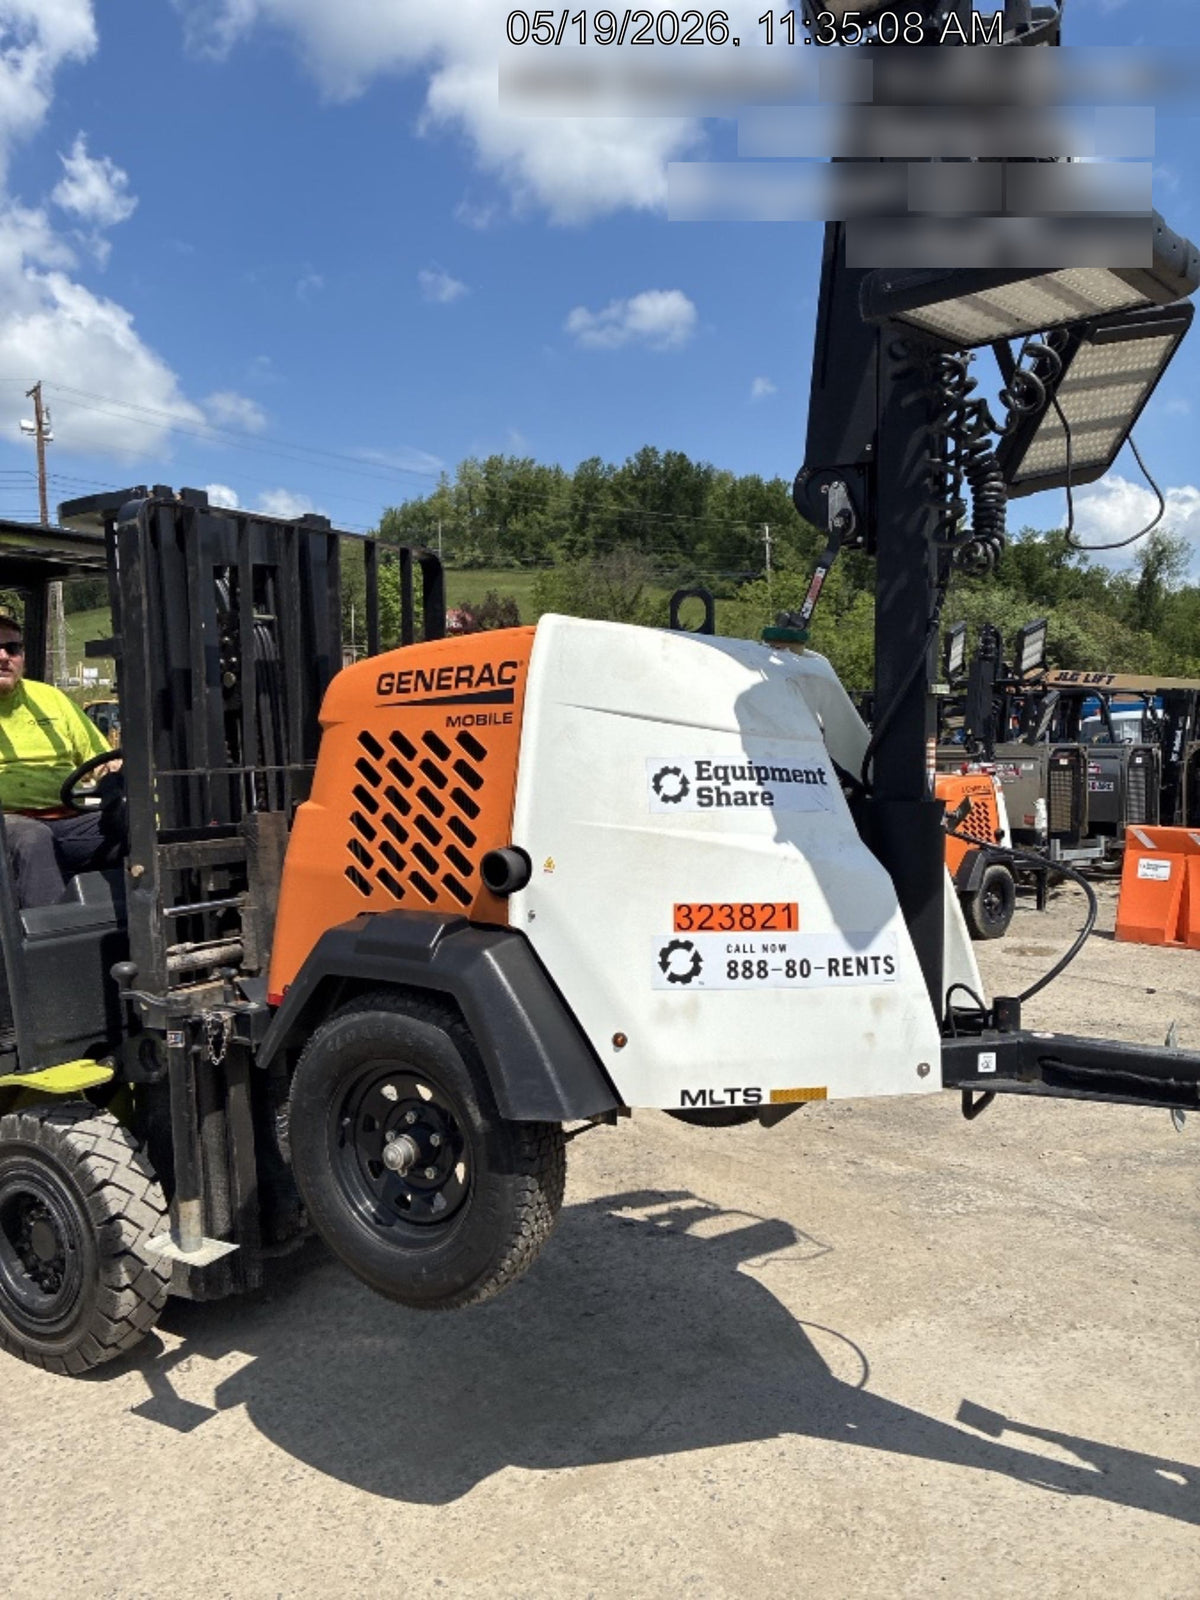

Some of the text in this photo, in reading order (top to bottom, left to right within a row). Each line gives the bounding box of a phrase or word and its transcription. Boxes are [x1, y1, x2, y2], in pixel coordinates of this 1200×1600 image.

[376, 661, 518, 696] GENERAC
[445, 712, 513, 728] MOBILE
[695, 761, 828, 786] Equipment
[696, 787, 774, 808] Share
[676, 904, 793, 931] 323821
[726, 944, 787, 954] CALL NOW
[726, 955, 896, 980] 888-80-RENTS
[680, 1087, 762, 1106] MLTS
